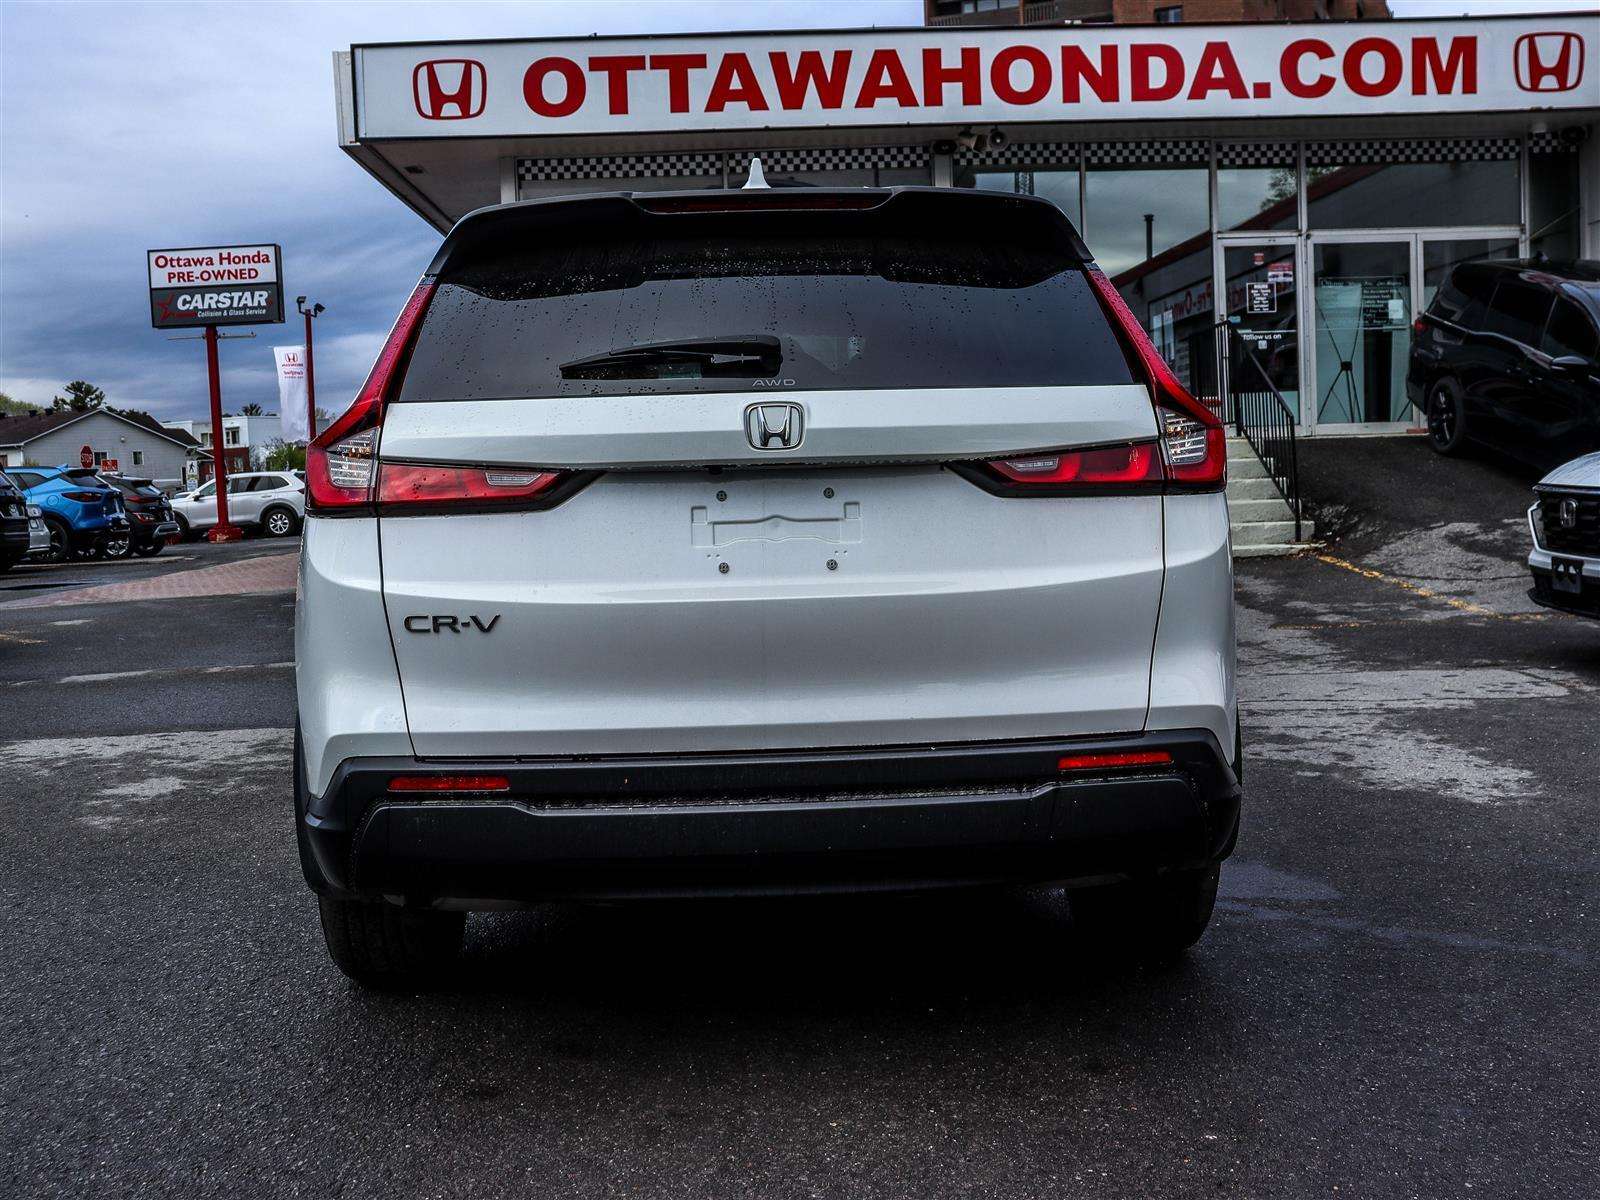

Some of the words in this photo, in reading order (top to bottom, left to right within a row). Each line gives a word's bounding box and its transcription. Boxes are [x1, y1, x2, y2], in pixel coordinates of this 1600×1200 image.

[523, 35, 1478, 118] OTTAWAHONDA.COM
[154, 254, 214, 269] Ottawa
[219, 251, 271, 266] Honda
[167, 268, 259, 283] PRE-OWNED
[177, 290, 269, 310] CARSTAR
[197, 309, 222, 317] Collision
[751, 378, 796, 387] AWD
[404, 614, 501, 633] CR-V
